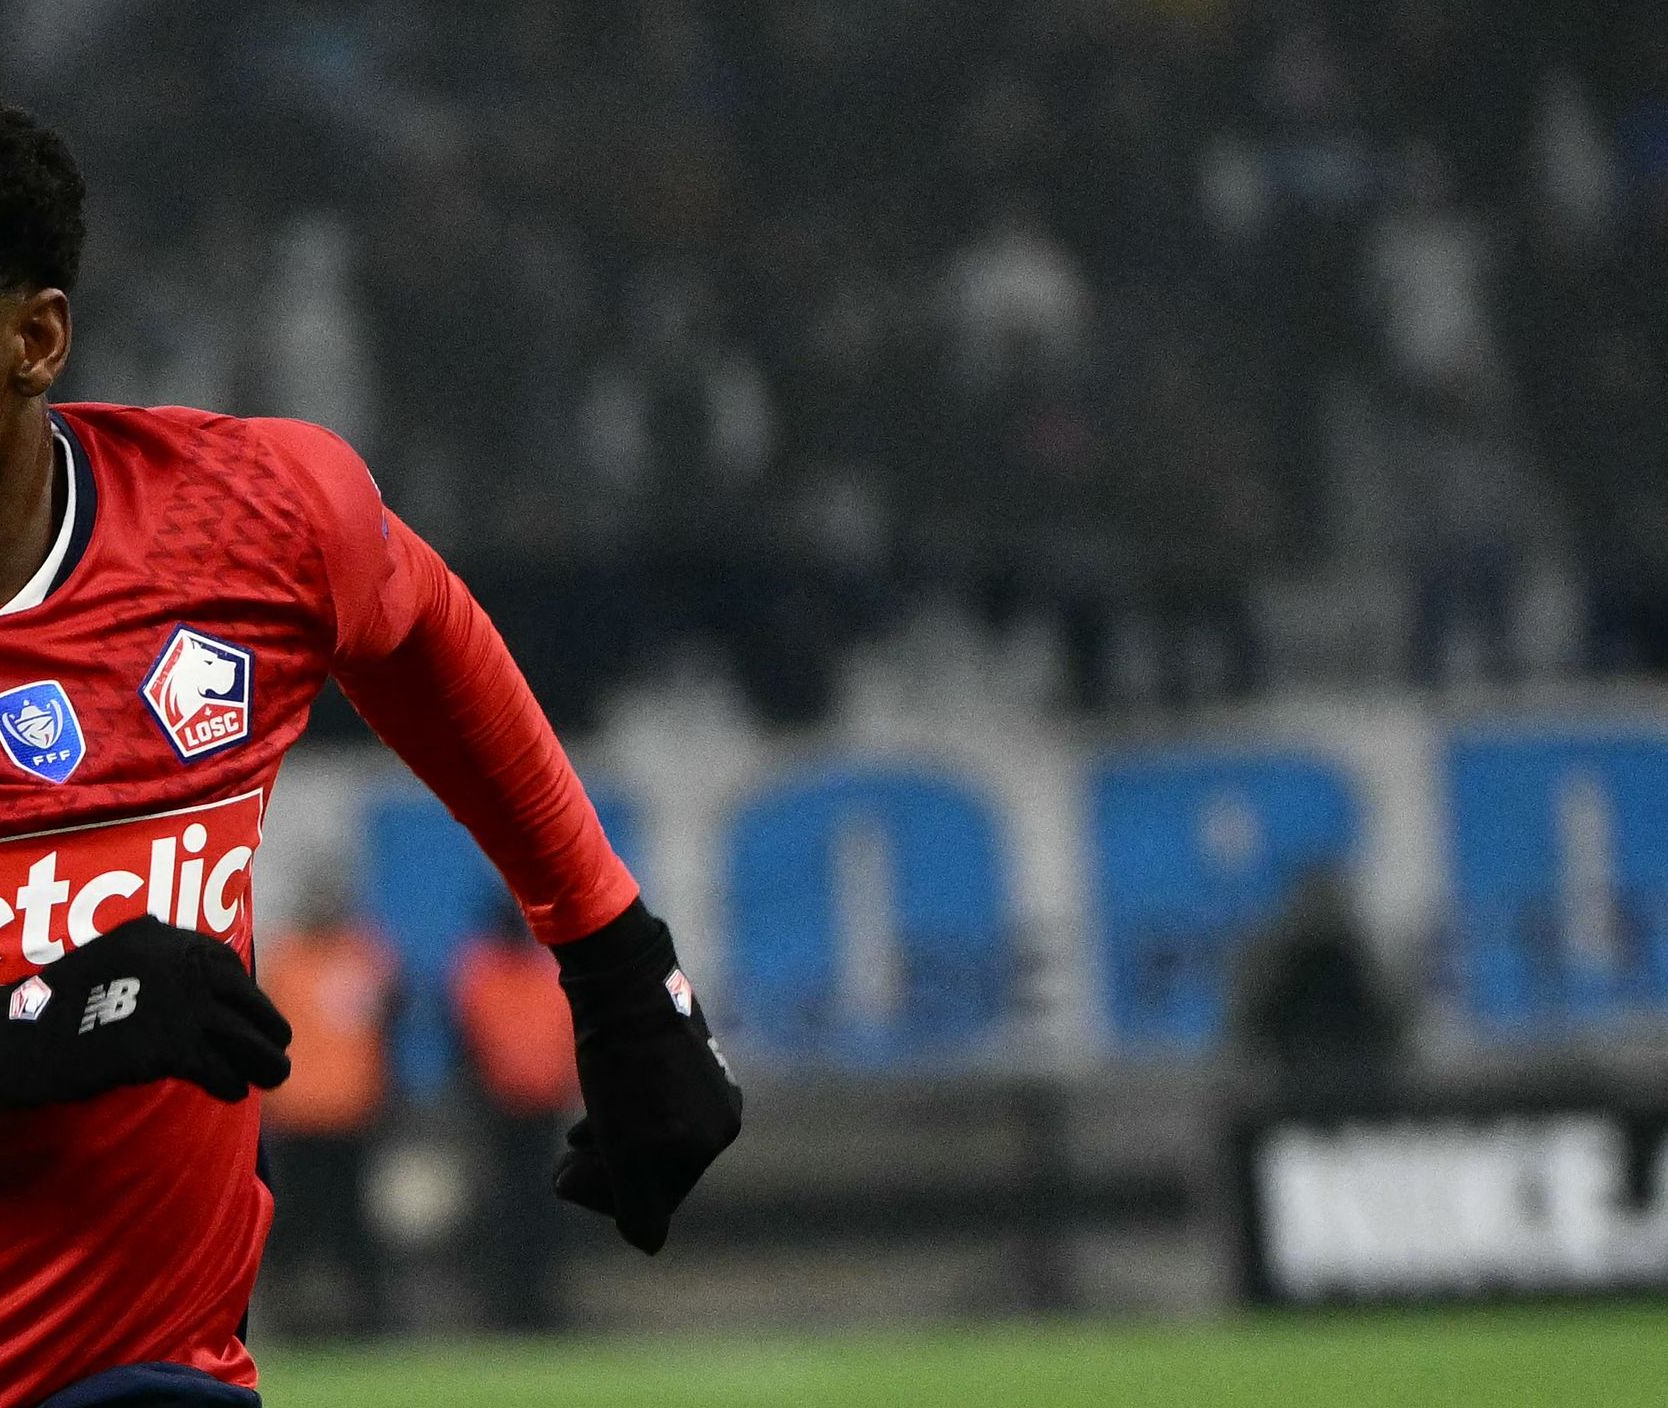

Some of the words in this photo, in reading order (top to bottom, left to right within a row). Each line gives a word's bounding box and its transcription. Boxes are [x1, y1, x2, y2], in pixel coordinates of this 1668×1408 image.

[183, 710, 240, 748] LOSC
[32, 749, 71, 767] FFF
[77, 976, 142, 1035] NB
